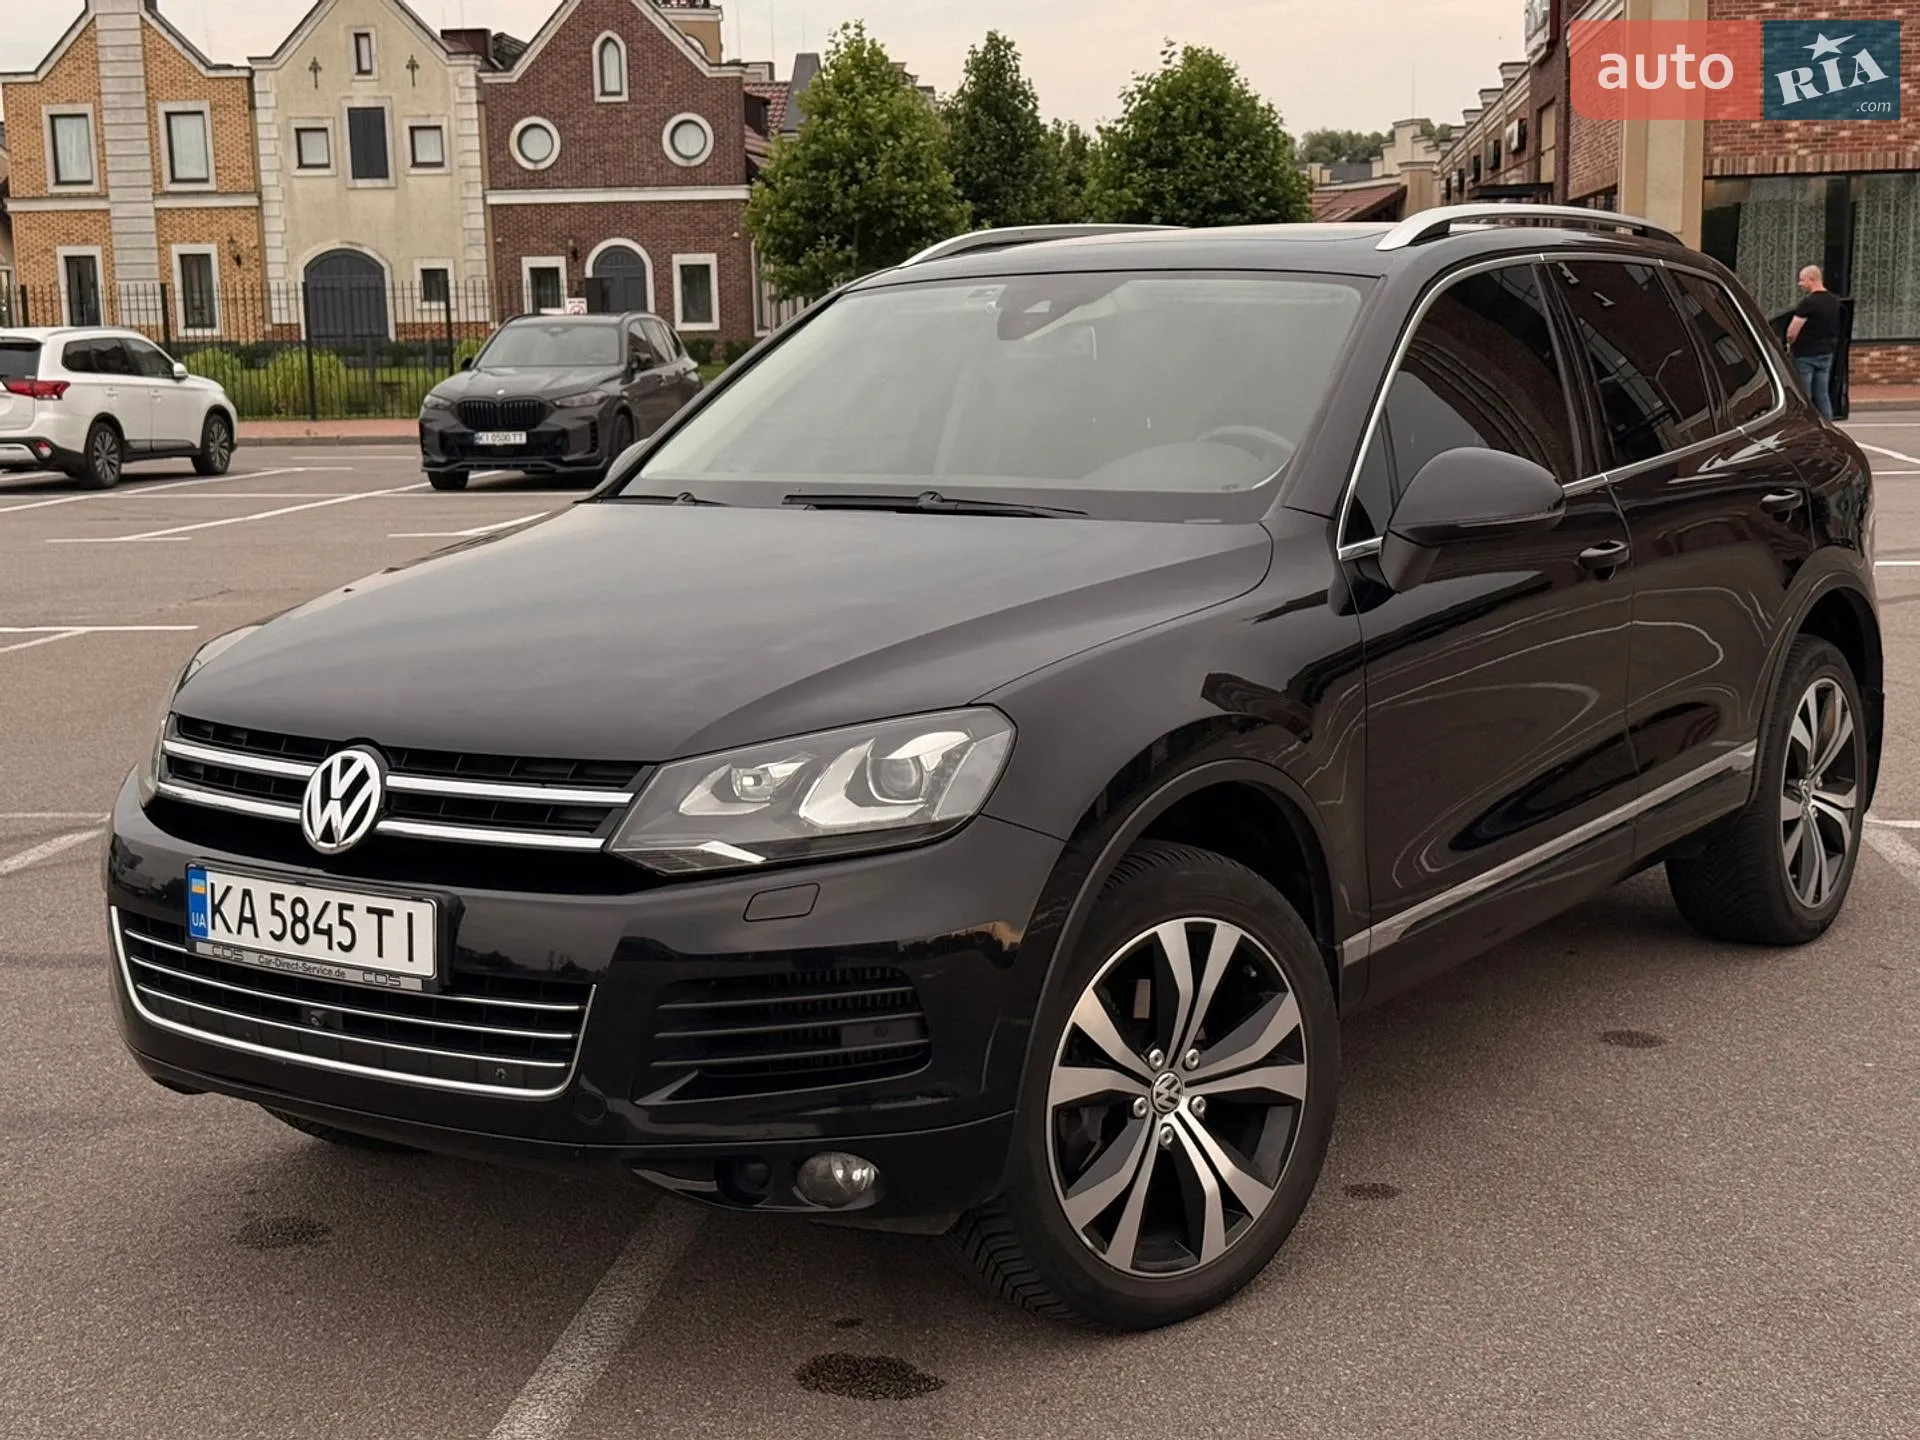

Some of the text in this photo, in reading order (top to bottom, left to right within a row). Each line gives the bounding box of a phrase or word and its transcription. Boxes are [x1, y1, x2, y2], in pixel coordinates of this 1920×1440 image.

[191, 913, 207, 928] UA
[210, 882, 414, 962] KA 5845 TI
[257, 954, 347, 978] Car-Direct-Service.de
